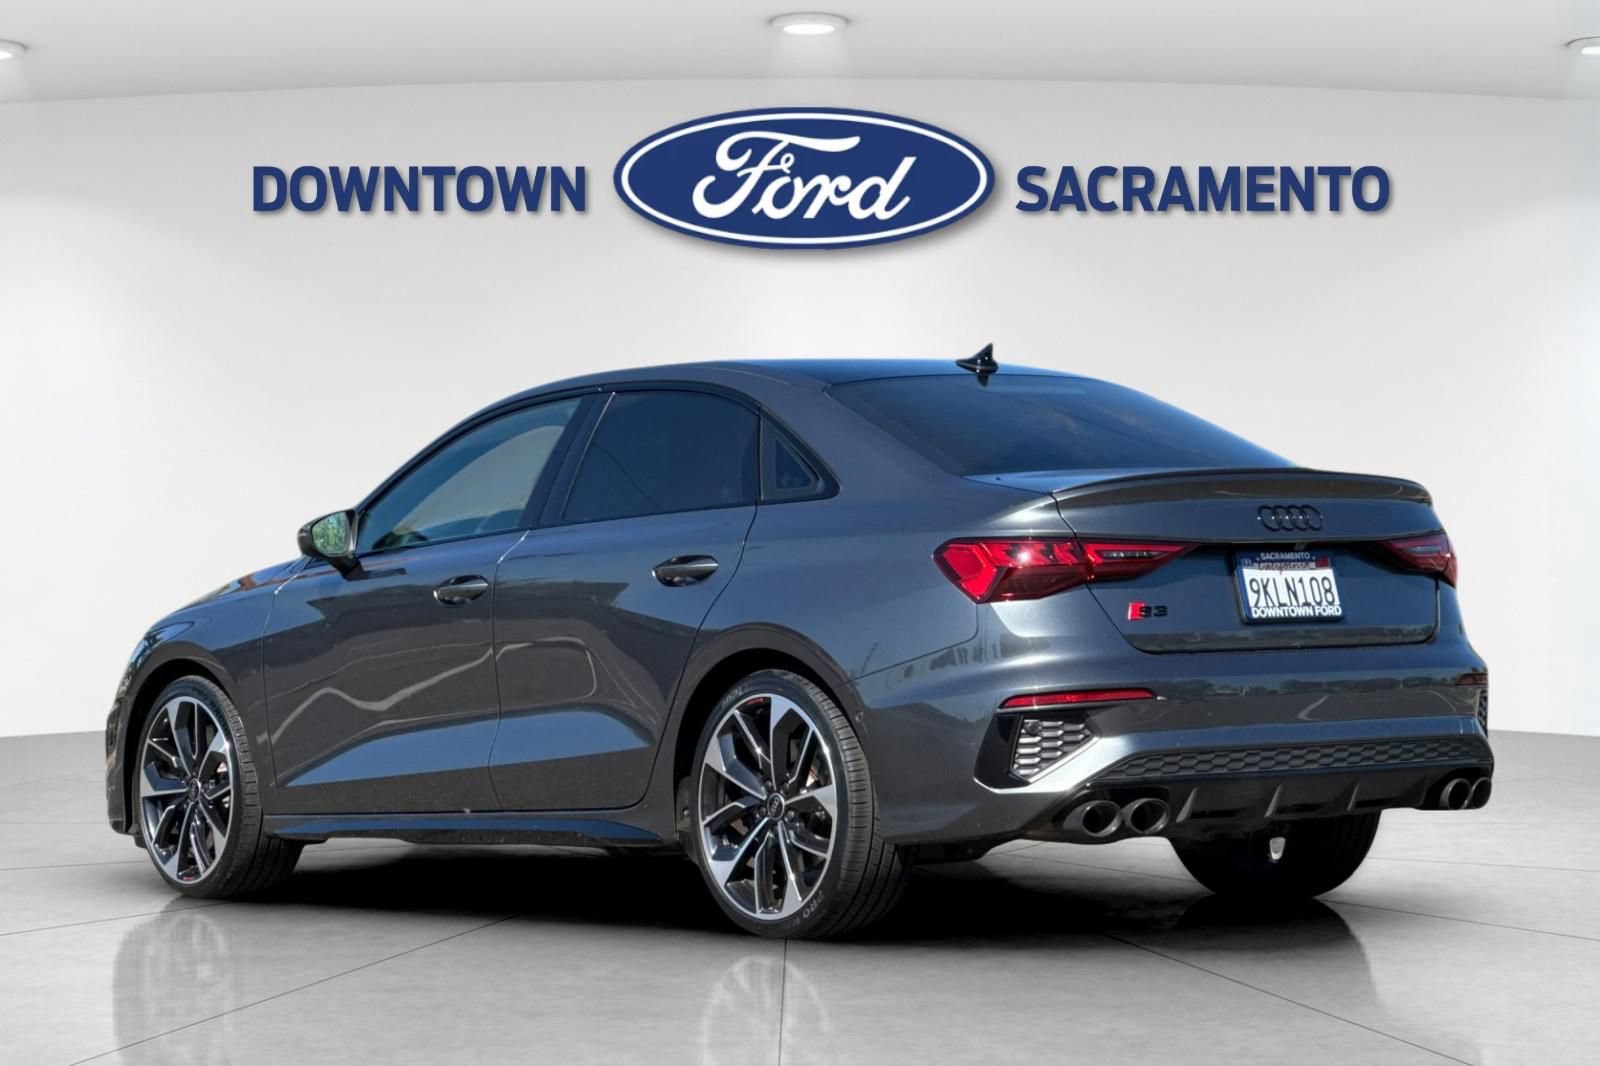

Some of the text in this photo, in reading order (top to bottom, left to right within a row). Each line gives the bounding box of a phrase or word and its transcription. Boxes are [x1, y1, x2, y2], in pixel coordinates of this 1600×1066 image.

[253, 131, 1390, 220] DOWNTOWN Ford SACRAMENTO
[1260, 552, 1311, 560] SACRAMENTO
[1249, 576, 1335, 607] 9KLN108
[1252, 605, 1342, 618] DOWNTOWN FORD
